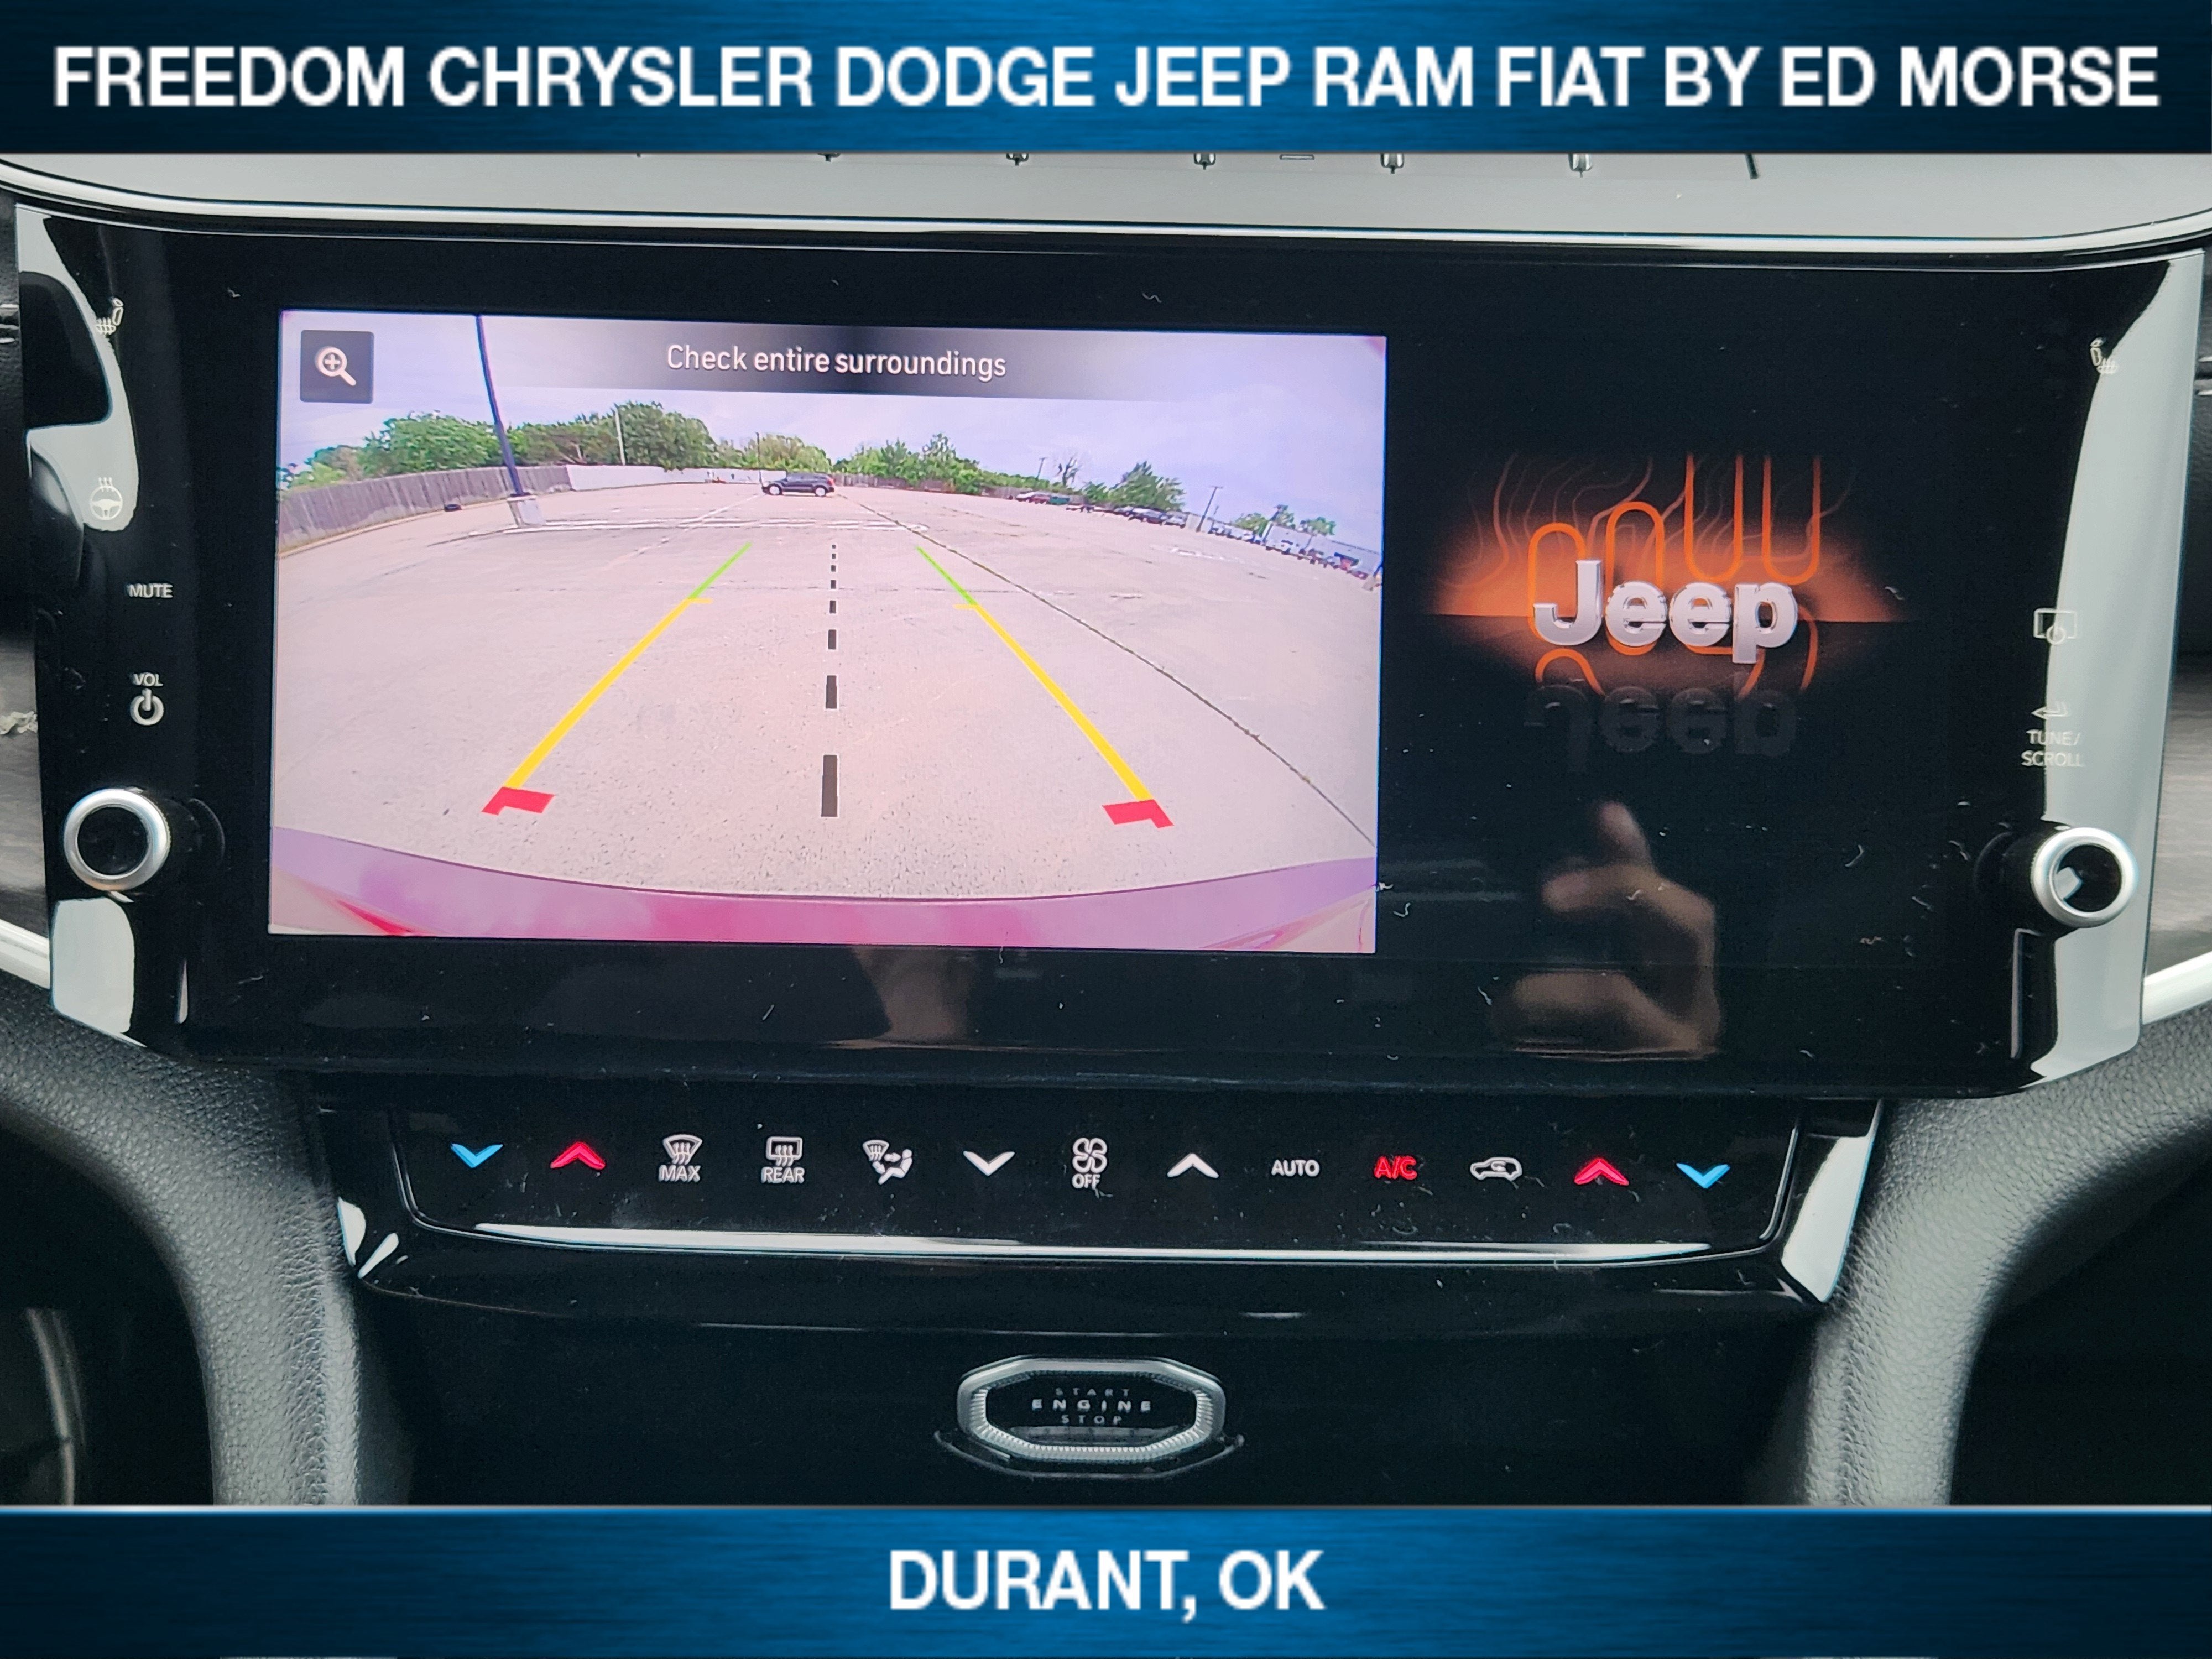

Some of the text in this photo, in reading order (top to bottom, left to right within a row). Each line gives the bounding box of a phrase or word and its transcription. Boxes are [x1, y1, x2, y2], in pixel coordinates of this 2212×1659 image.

[666, 344, 1006, 383] Check entire surroundings
[126, 582, 174, 598] MUTE
[1533, 559, 1798, 664] Jeep
[132, 671, 164, 687] VOL
[2025, 728, 2081, 746] TUNE/
[2021, 750, 2085, 768] SCROLL
[658, 1165, 701, 1182] MAX
[761, 1166, 805, 1184] REAR
[1271, 1159, 1321, 1177] AUTO
[1374, 1155, 1418, 1181] A/C
[1072, 1173, 1100, 1190] OFF
[1055, 1387, 1129, 1397] START
[1031, 1399, 1151, 1413] ENGINE
[1061, 1415, 1122, 1425] STOP
